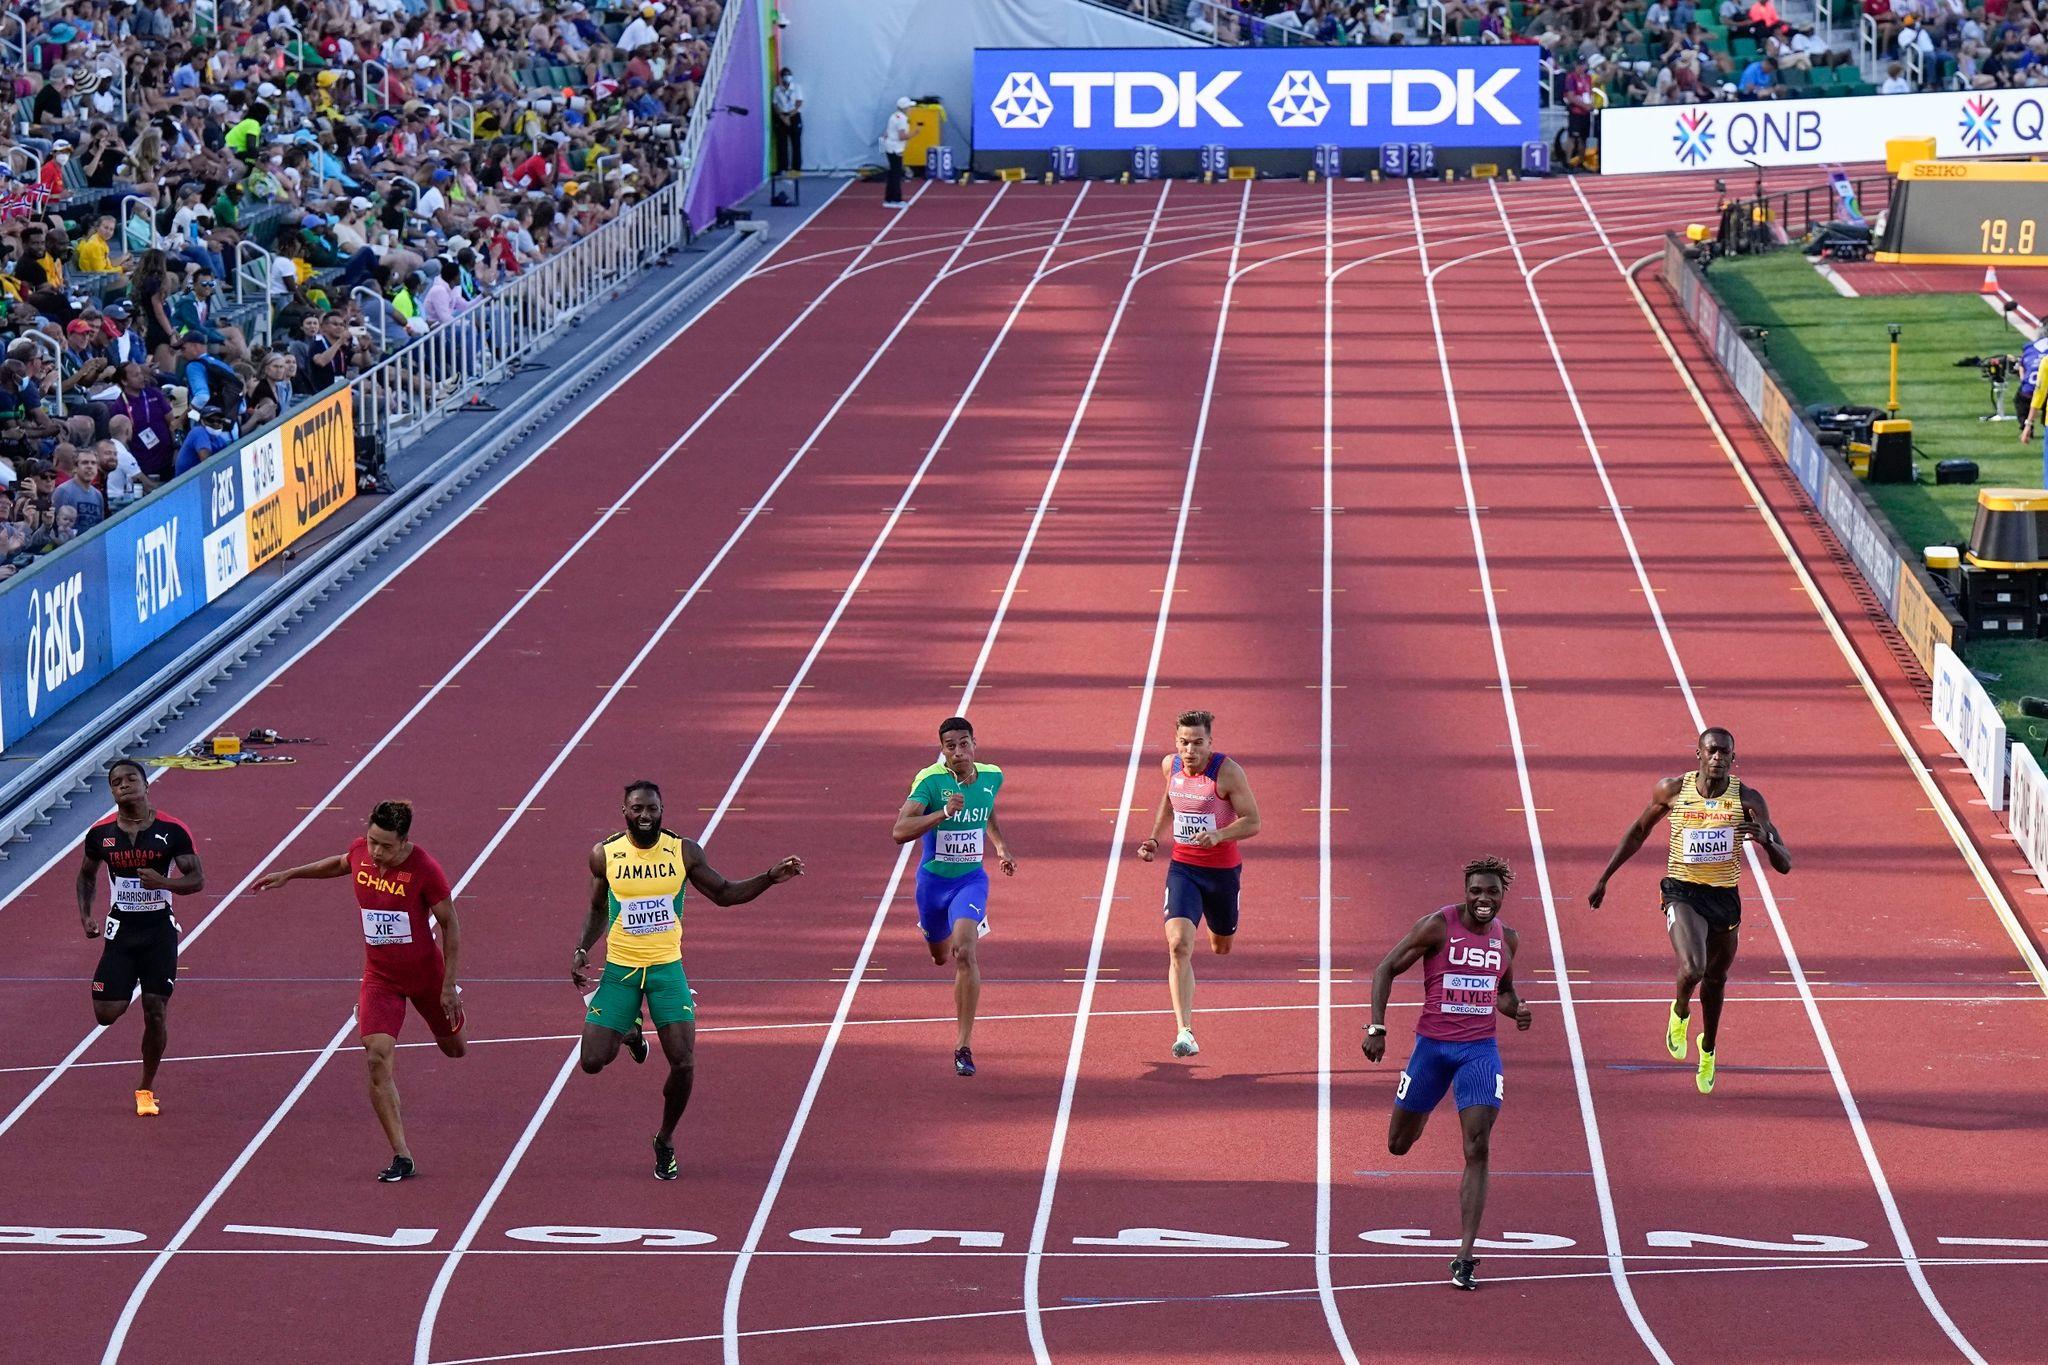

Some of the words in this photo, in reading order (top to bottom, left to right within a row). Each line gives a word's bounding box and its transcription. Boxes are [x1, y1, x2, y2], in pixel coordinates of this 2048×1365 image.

[1049, 71, 1244, 128] TDK
[1326, 68, 1522, 126] TDK
[1727, 110, 1822, 155] QNB
[1065, 152, 1076, 170] 7
[1134, 151, 1144, 169] 6
[1150, 151, 1160, 169] 6
[1215, 151, 1226, 168] 5
[1329, 150, 1339, 167] 4
[1385, 149, 1400, 167] 3
[1425, 149, 1434, 167] 2
[1530, 149, 1541, 166] 1
[1913, 164, 1968, 177] SEIKO
[1980, 218, 2037, 255] 19.8
[292, 399, 346, 526] SEIKO
[251, 495, 283, 562] SEIKO
[220, 531, 238, 581] TDK
[144, 516, 183, 615] TDK
[44, 571, 85, 692] asics
[946, 807, 989, 823] RASIL
[1184, 815, 1208, 824] TDK
[1683, 811, 1734, 822] GERMANY
[952, 831, 977, 842] TDK
[1697, 830, 1726, 840] TDK
[945, 843, 976, 854] VILAR
[1689, 842, 1728, 854] ANSAH
[1690, 855, 1726, 863] OREGON22
[615, 862, 677, 880] JAMAICA
[356, 870, 406, 897] CHINA
[117, 890, 152, 902] HARRISON
[637, 898, 666, 911] TDK
[373, 912, 401, 922] TDK
[628, 909, 669, 926] DWYER
[106, 921, 114, 936] 8
[375, 924, 394, 935] XIE
[631, 925, 669, 935] OREGON22
[1448, 946, 1502, 971] USA
[1461, 976, 1490, 989] TDK
[1446, 990, 1458, 1003] N.
[1461, 989, 1492, 1004] LYLES
[1450, 1005, 1488, 1014] OREGON22
[223, 1224, 438, 1248] 7
[505, 1225, 718, 1247] 6
[788, 1227, 1005, 1248] 5
[1072, 1227, 1290, 1250] 4
[1358, 1228, 1577, 1250] 3
[1646, 1231, 1868, 1253] 2
